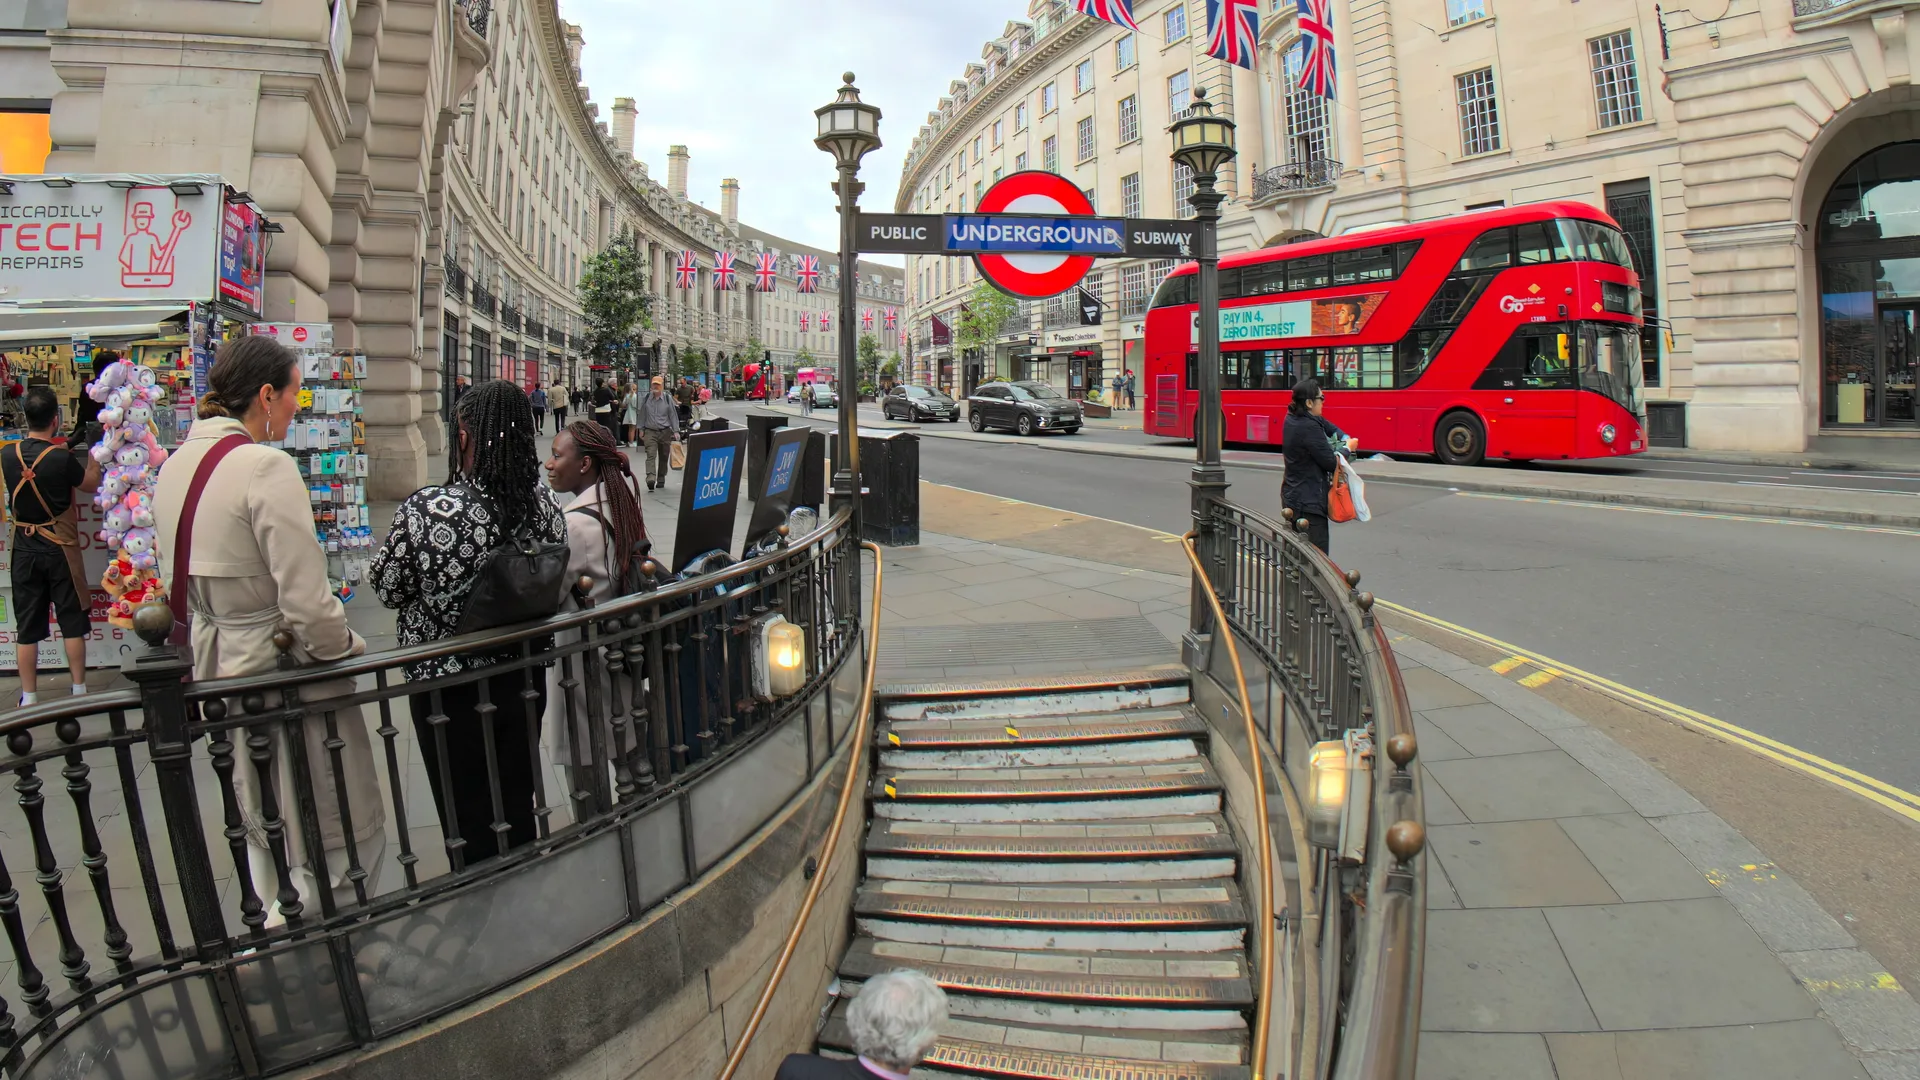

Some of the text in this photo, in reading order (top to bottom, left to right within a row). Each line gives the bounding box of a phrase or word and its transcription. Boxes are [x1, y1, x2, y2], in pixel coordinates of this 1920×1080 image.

[0, 205, 103, 218] ICCADILLY
[227, 211, 245, 229] LONDON
[0, 223, 102, 251] TECH
[226, 224, 238, 241] FROM
[871, 224, 1193, 246] PUBLIC UNDERGROUND SUBWAY
[225, 240, 234, 254] THE
[1, 256, 84, 270] REPAIRS
[1223, 310, 1264, 325] PAY IN 4,
[1223, 322, 1296, 339] ZERO INTEREST
[704, 456, 729, 480] JW
[777, 450, 794, 472] JW
[771, 471, 789, 489] .ORG
[699, 481, 725, 500] .ORG
[0, 631, 18, 644] SI
[112, 628, 124, 640] &
